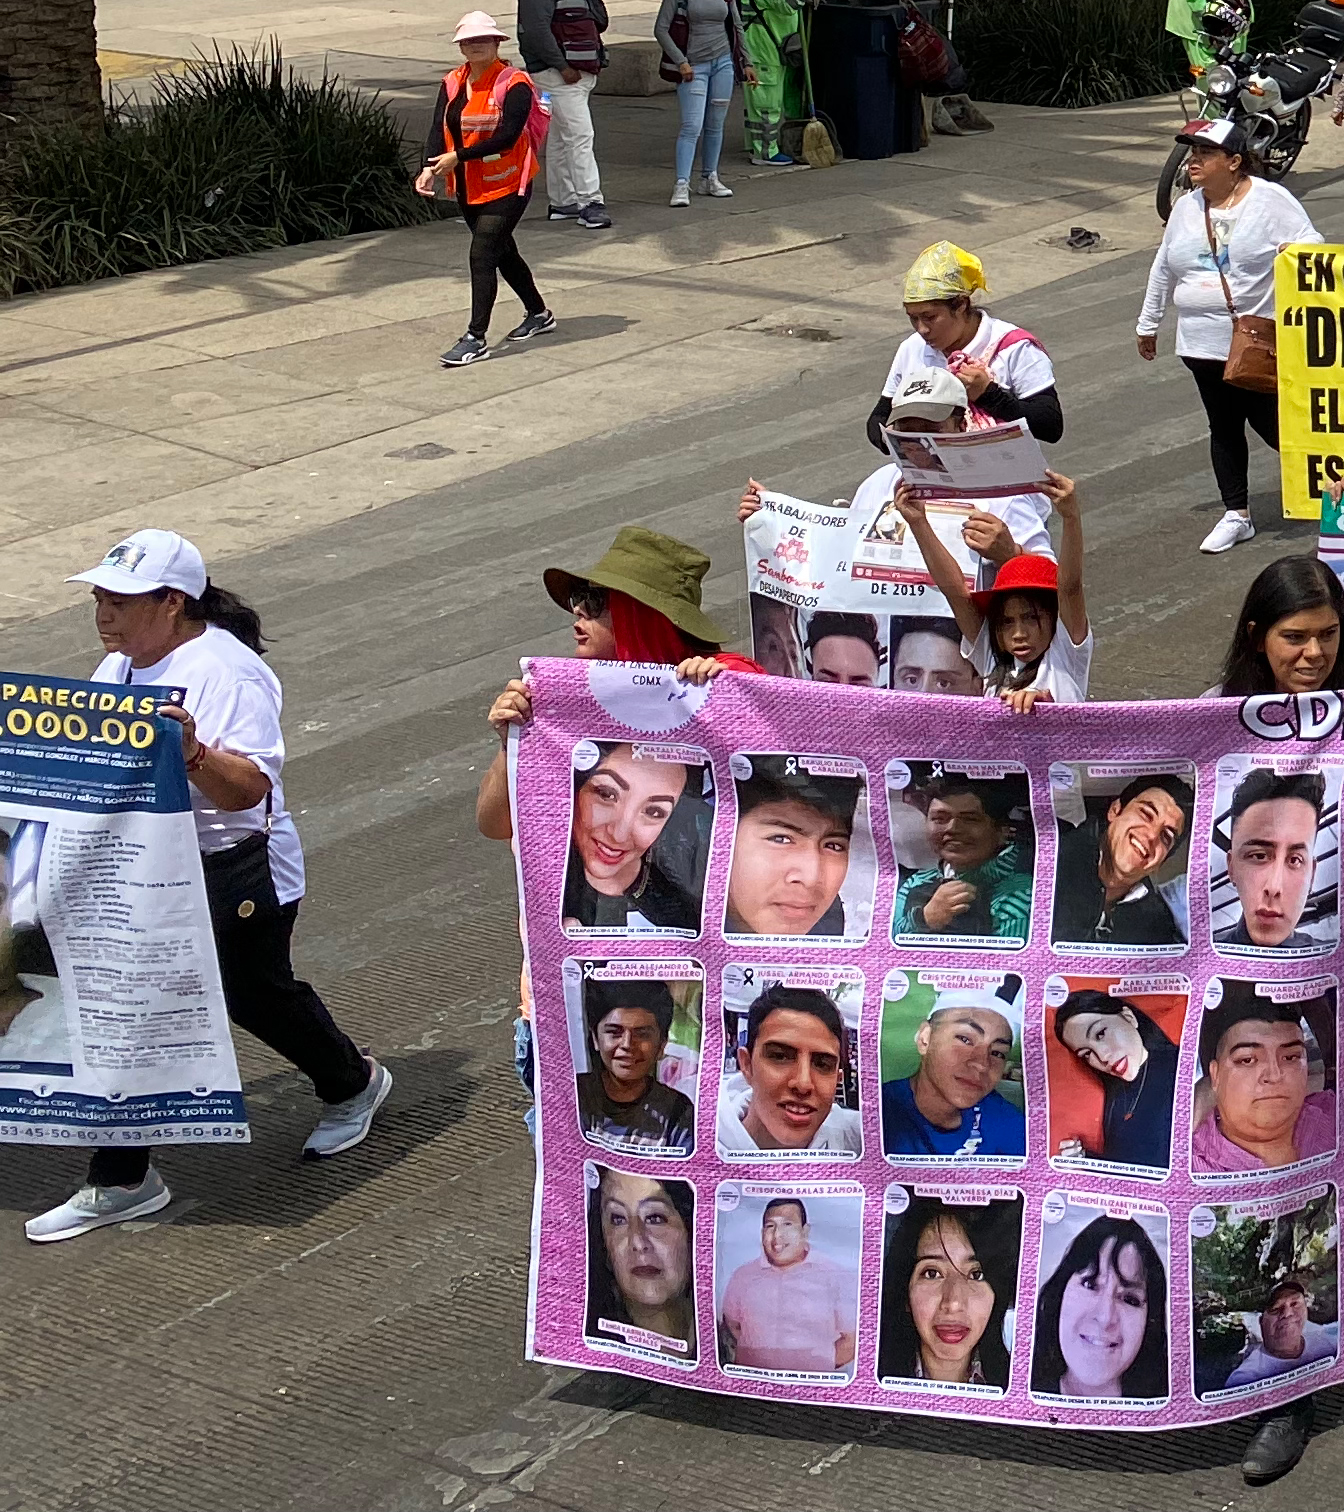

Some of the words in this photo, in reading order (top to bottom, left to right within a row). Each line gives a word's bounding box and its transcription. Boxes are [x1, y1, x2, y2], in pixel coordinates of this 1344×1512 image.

[1297, 251, 1337, 293] EN
[1311, 388, 1344, 433] EL
[764, 500, 848, 528] TRABAJADORES
[788, 525, 807, 539] DE
[871, 583, 890, 595] DE
[893, 584, 925, 597] 2019
[633, 674, 662, 686] CDMX
